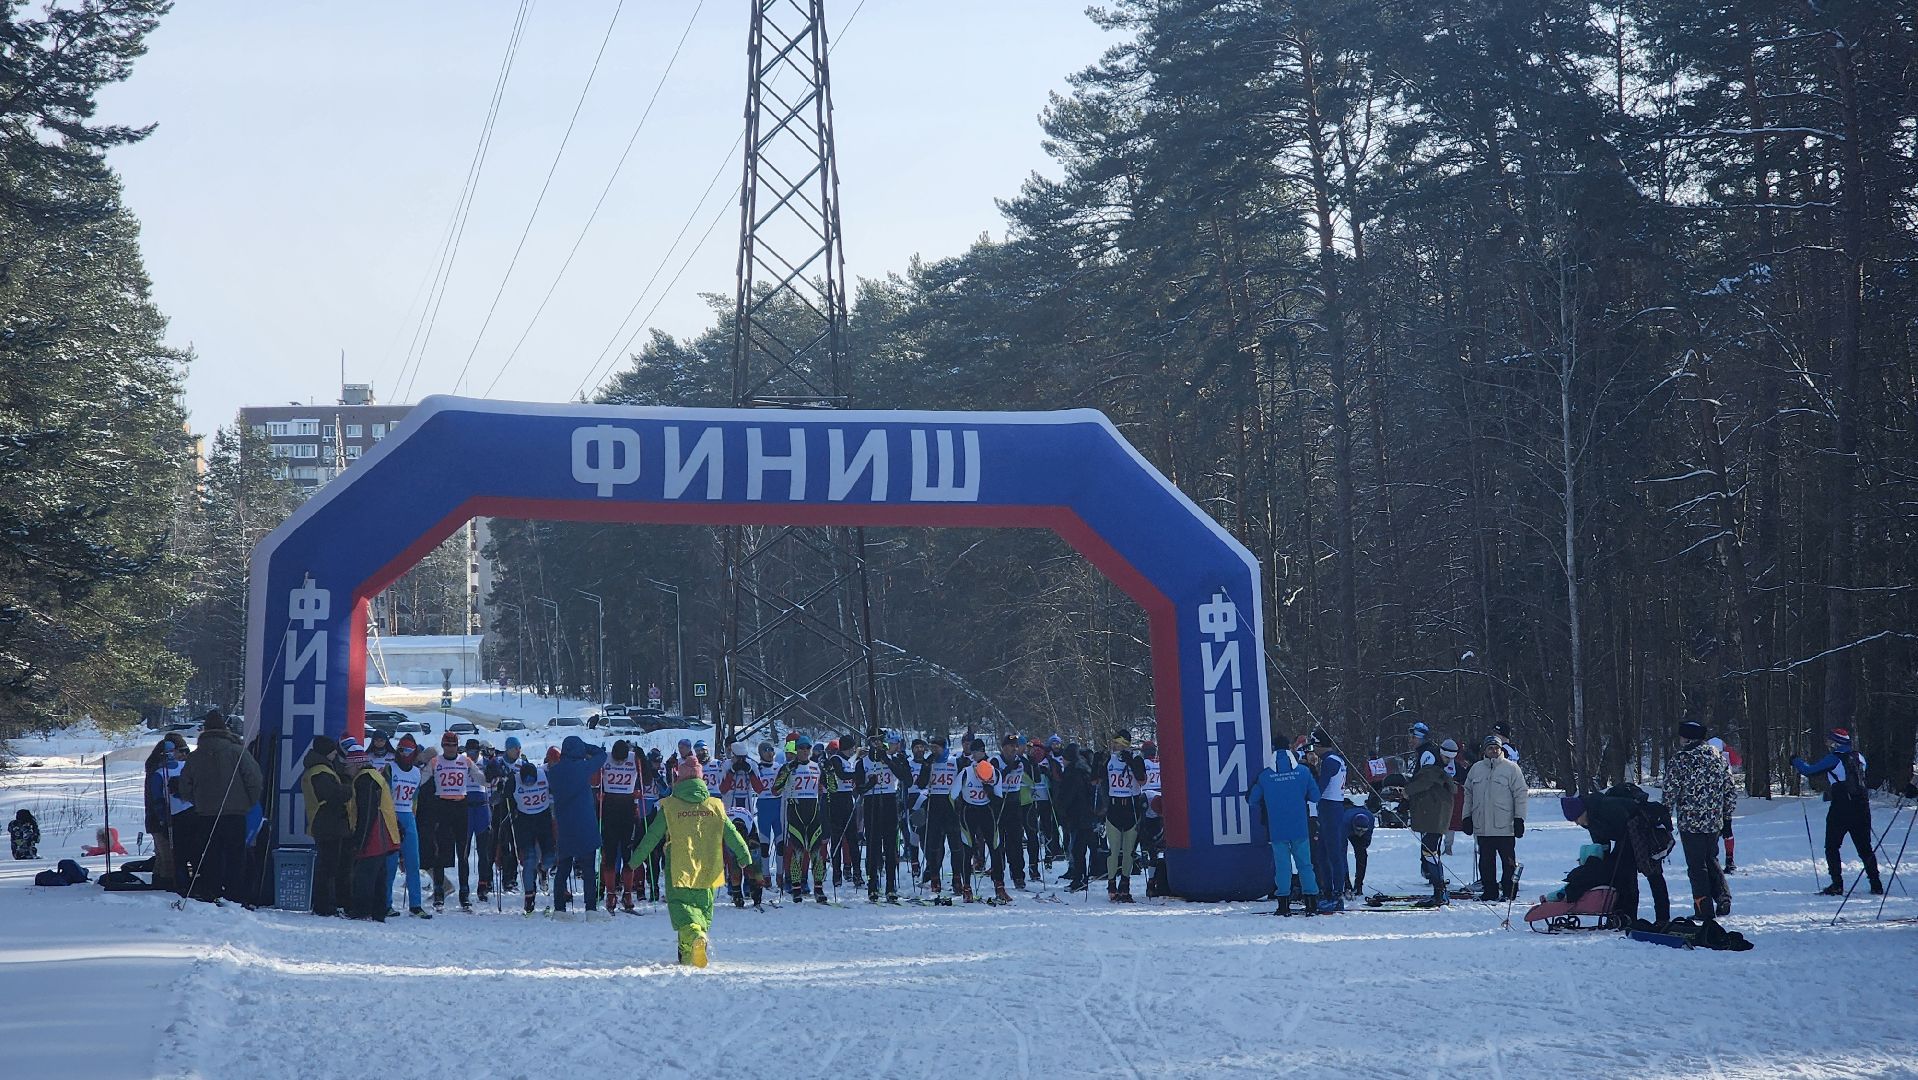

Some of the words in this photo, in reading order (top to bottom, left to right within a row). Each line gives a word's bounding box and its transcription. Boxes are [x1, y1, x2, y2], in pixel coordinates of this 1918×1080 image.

[571, 424, 981, 502] ФИНИШ
[278, 578, 331, 845] ФИНИШ
[1198, 593, 1251, 845] ФИНИШ
[440, 772, 465, 787] 258
[607, 773, 632, 786] 222
[795, 776, 818, 791] 277
[931, 773, 954, 786] 245
[1111, 773, 1134, 788] 262
[523, 791, 547, 806] 226
